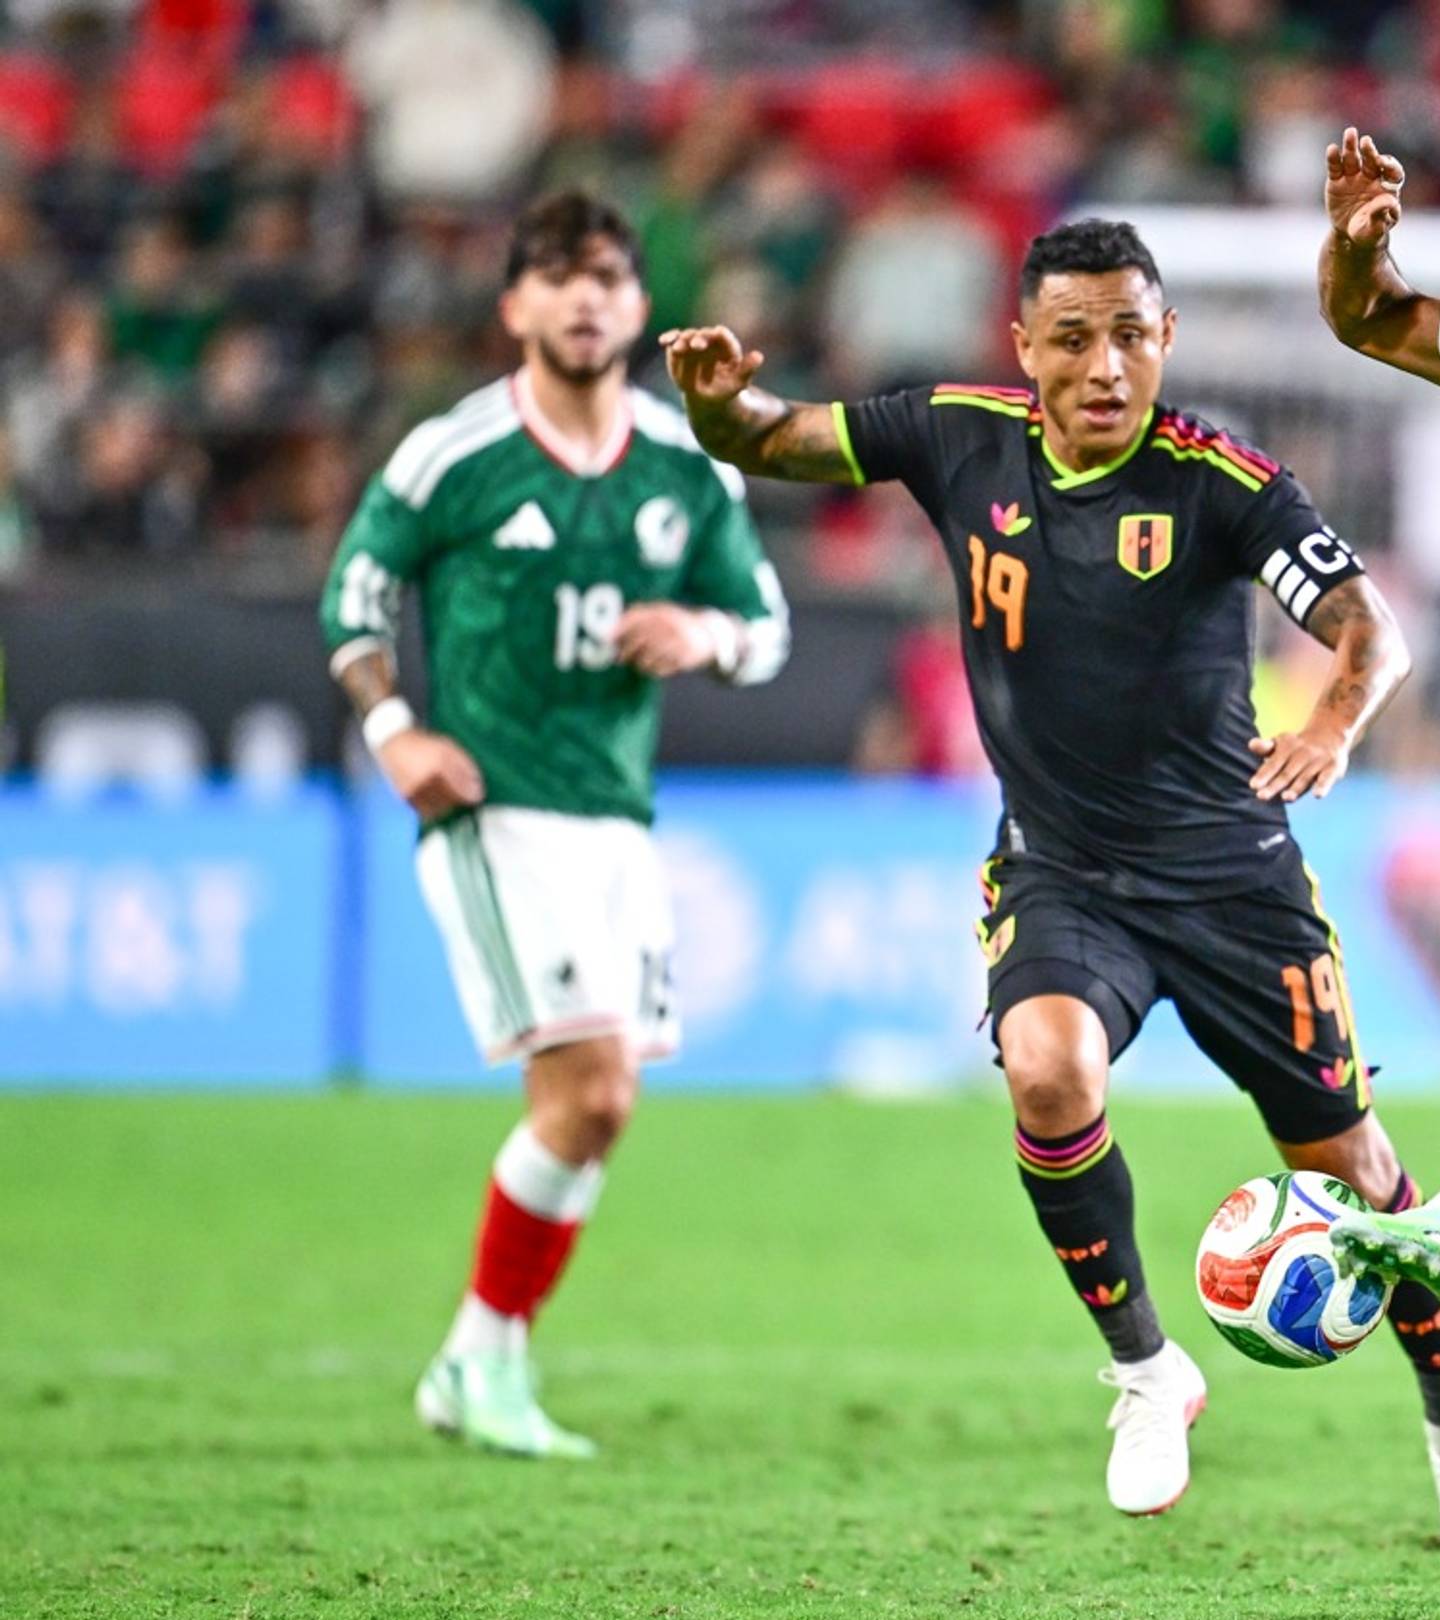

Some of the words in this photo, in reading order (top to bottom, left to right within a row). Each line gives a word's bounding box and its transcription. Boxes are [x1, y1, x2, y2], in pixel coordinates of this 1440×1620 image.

[968, 534, 1029, 652] 19
[1299, 532, 1350, 575] C
[554, 582, 624, 671] 19
[0, 857, 258, 1012] T&T
[1281, 952, 1349, 1054] 19
